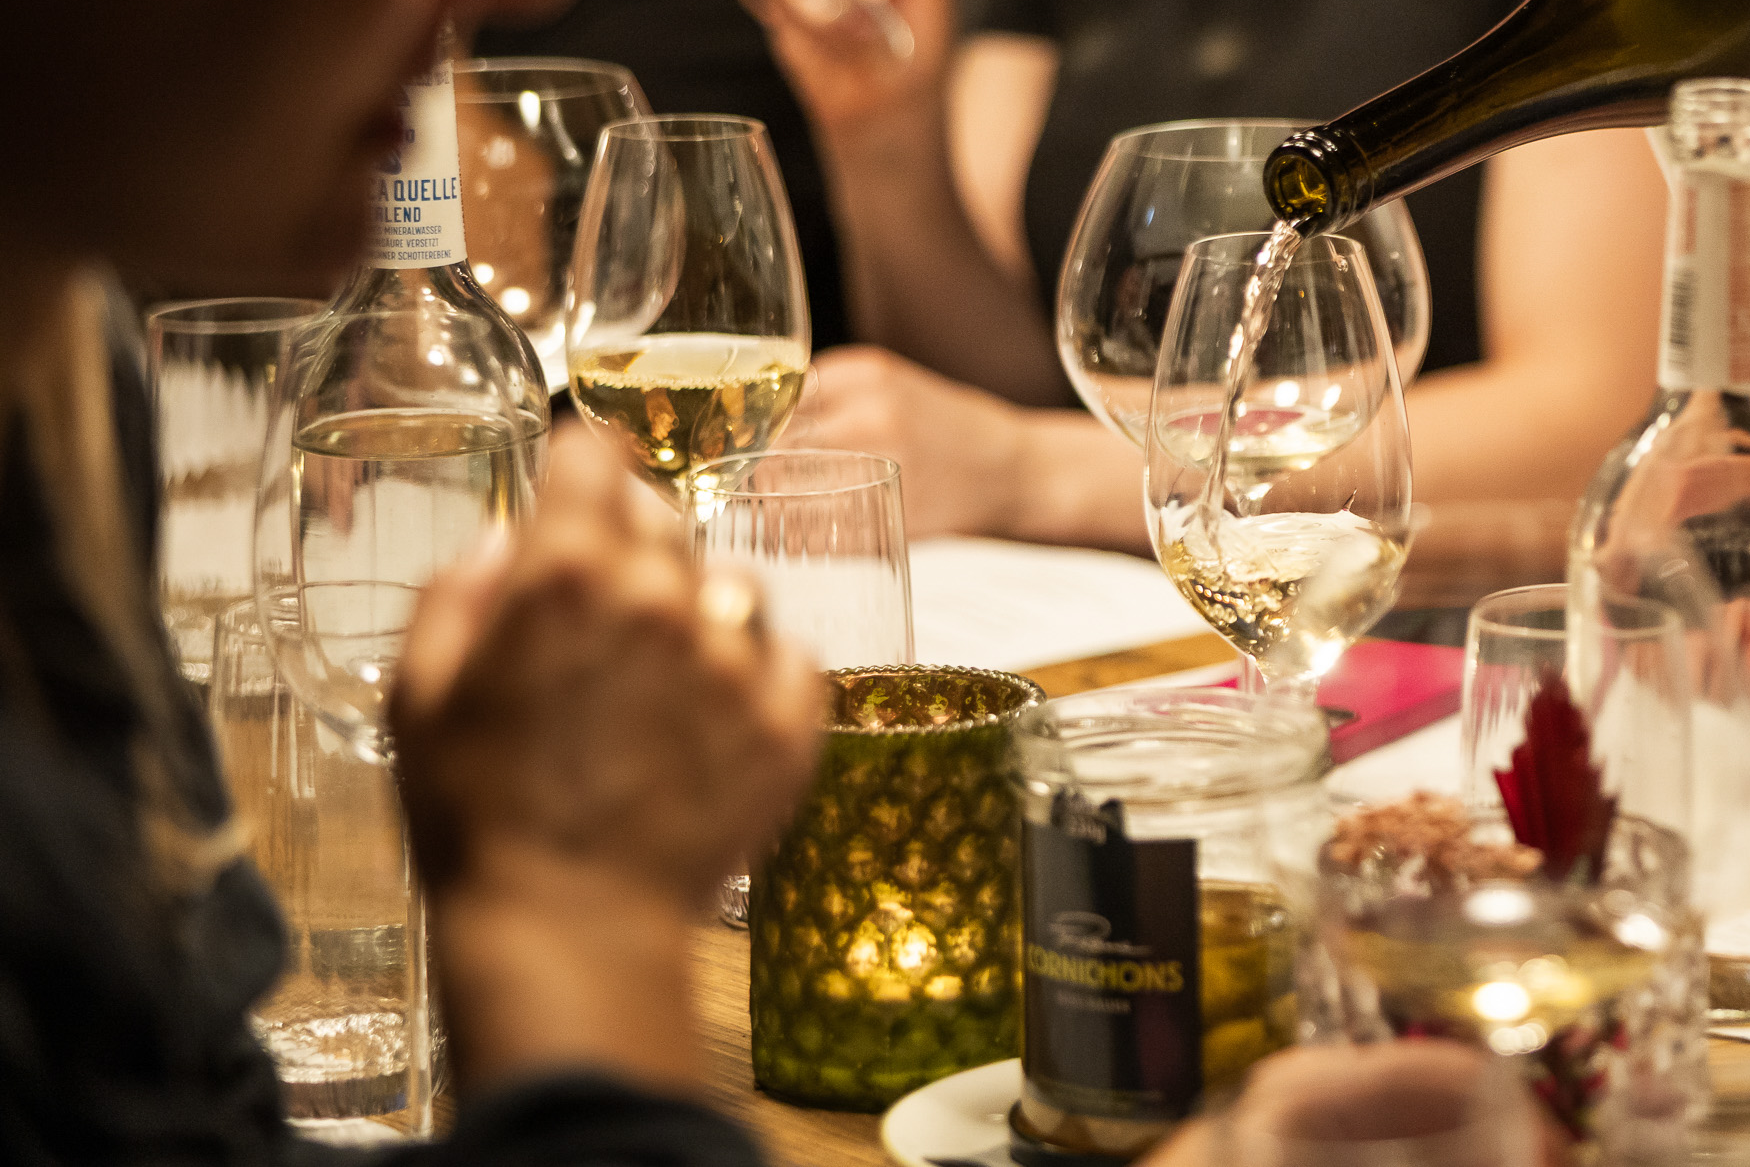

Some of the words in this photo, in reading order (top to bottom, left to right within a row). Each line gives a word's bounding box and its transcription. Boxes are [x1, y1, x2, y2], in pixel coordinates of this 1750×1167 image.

[394, 177, 458, 202] QUELLE
[384, 225, 442, 235] MINERALWASSER
[406, 237, 439, 248] VERSETZT
[398, 249, 452, 261] SCHOTTEREBENE
